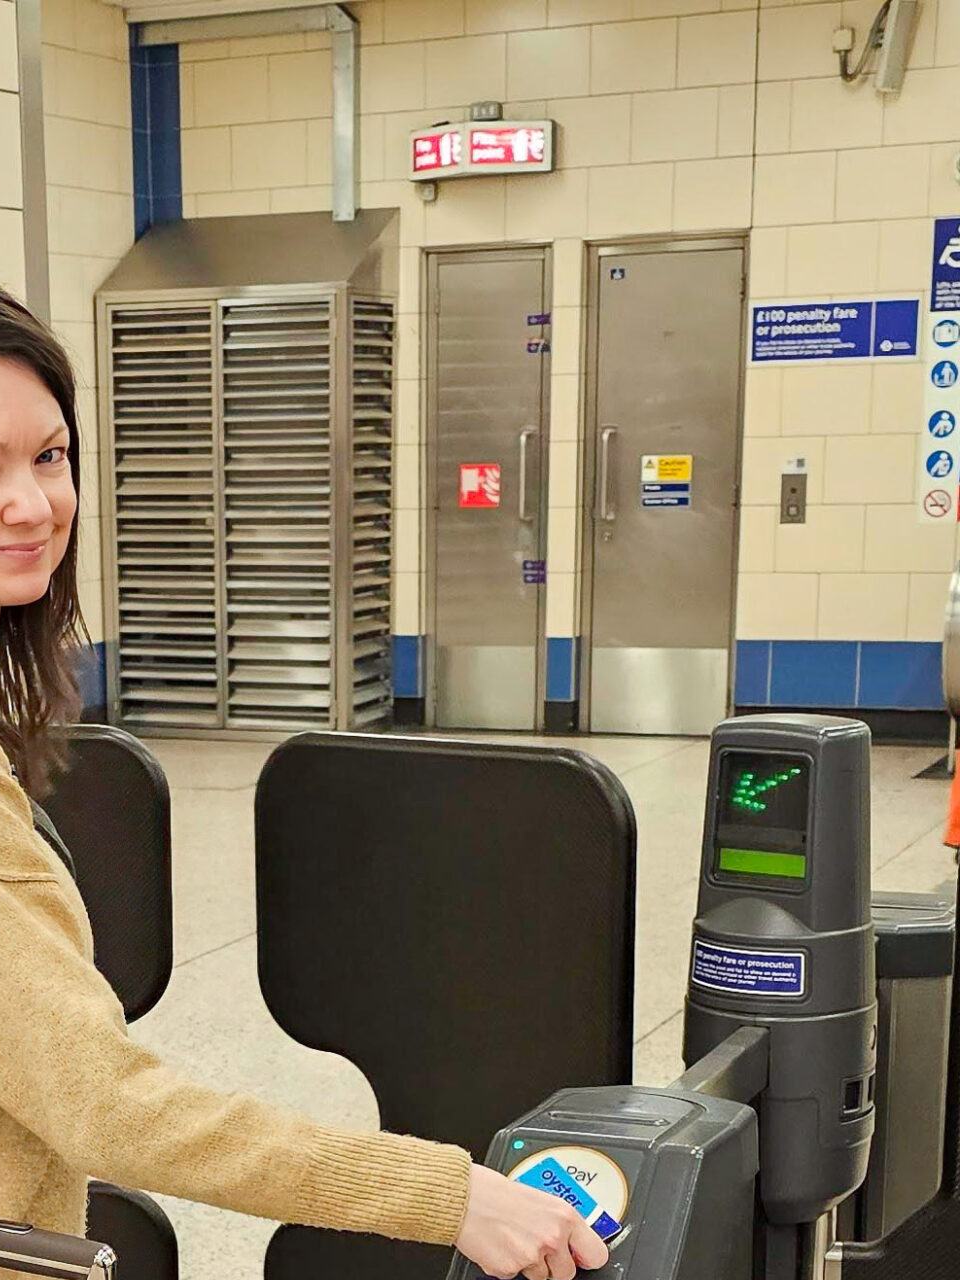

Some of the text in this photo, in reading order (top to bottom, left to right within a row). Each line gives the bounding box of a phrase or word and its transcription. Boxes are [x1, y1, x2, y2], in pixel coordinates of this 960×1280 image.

[786, 308, 831, 323] penalty
[833, 306, 858, 319] fare
[756, 322, 841, 338] or prosecution
[738, 958, 746, 966] or
[747, 960, 795, 969] prosecution
[541, 1170, 583, 1208] oyster
